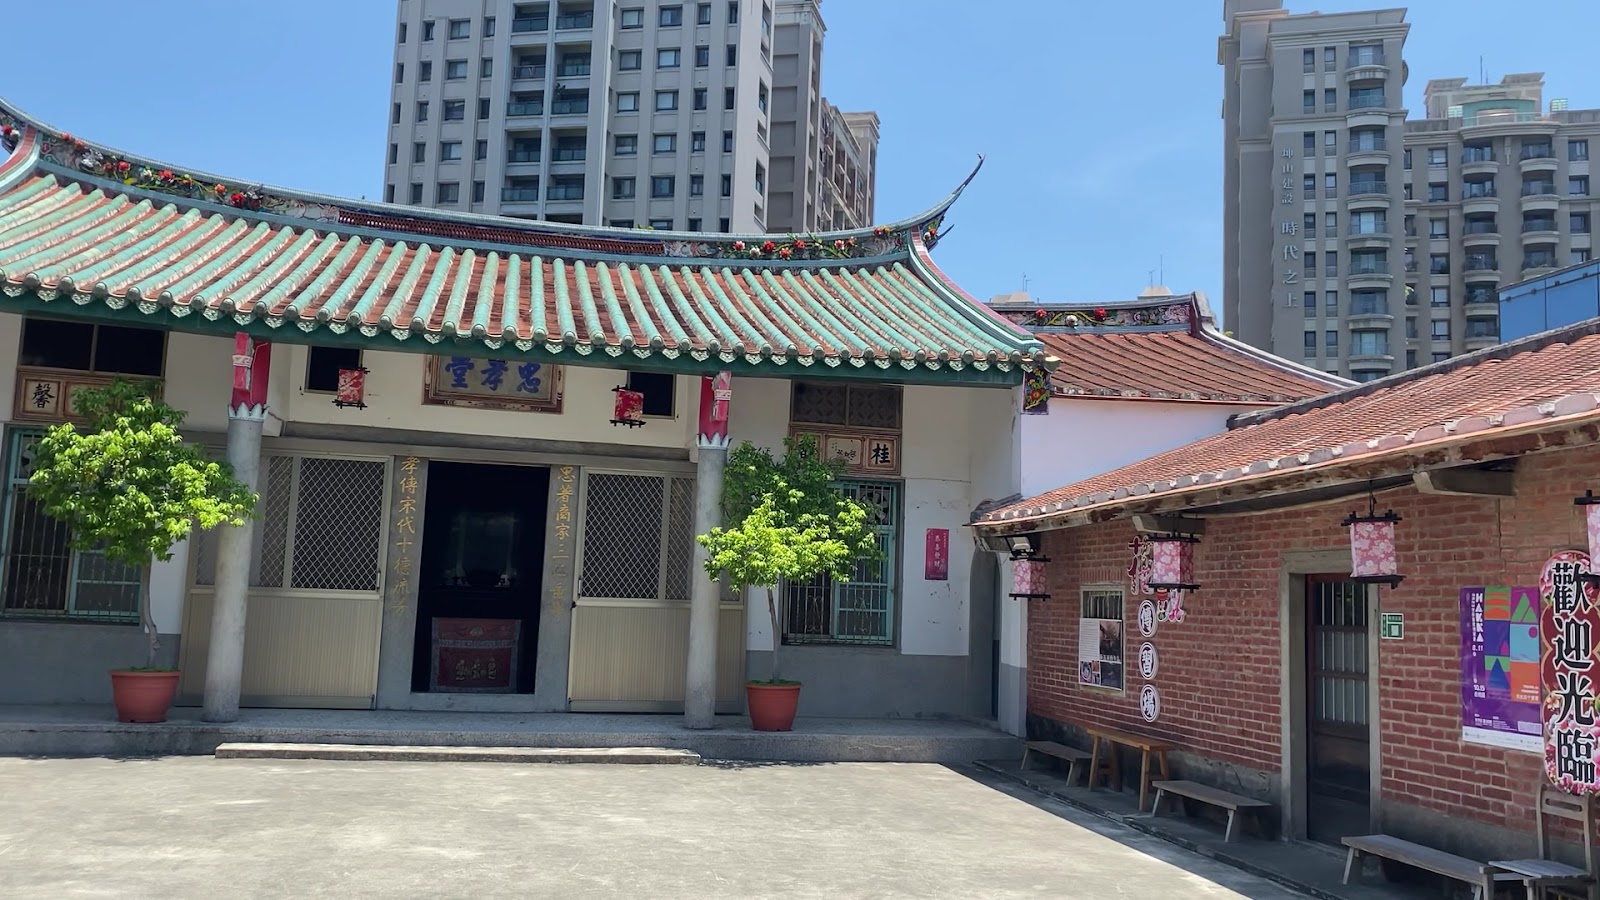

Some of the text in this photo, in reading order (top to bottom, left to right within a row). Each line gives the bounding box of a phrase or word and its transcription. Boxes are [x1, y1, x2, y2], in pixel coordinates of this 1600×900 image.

[1281, 221, 1299, 308] 時代之上
[32, 382, 56, 410] 馨
[871, 443, 890, 465] 桂
[1475, 593, 1484, 642] HAKKA
[1552, 562, 1596, 784] 歡迎光臨
